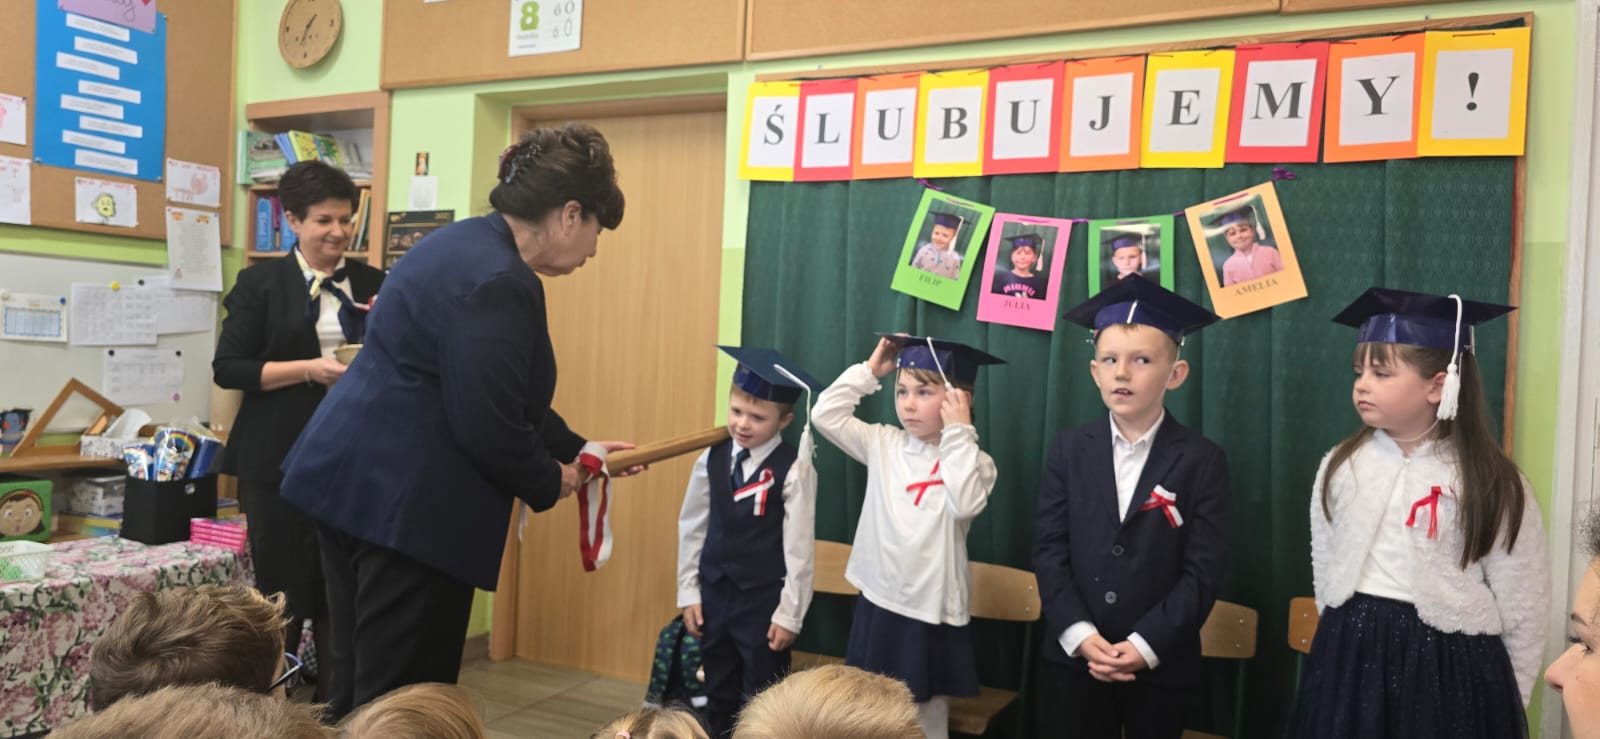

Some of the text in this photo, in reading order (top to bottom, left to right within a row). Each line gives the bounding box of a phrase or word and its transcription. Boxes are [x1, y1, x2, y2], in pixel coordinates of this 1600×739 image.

[520, 1, 540, 31] 8
[763, 71, 1480, 146] ŚLUBUJEMY!
[918, 274, 943, 287] FILIP
[1234, 278, 1279, 297] AMELIA
[1003, 299, 1031, 312] JULIA
